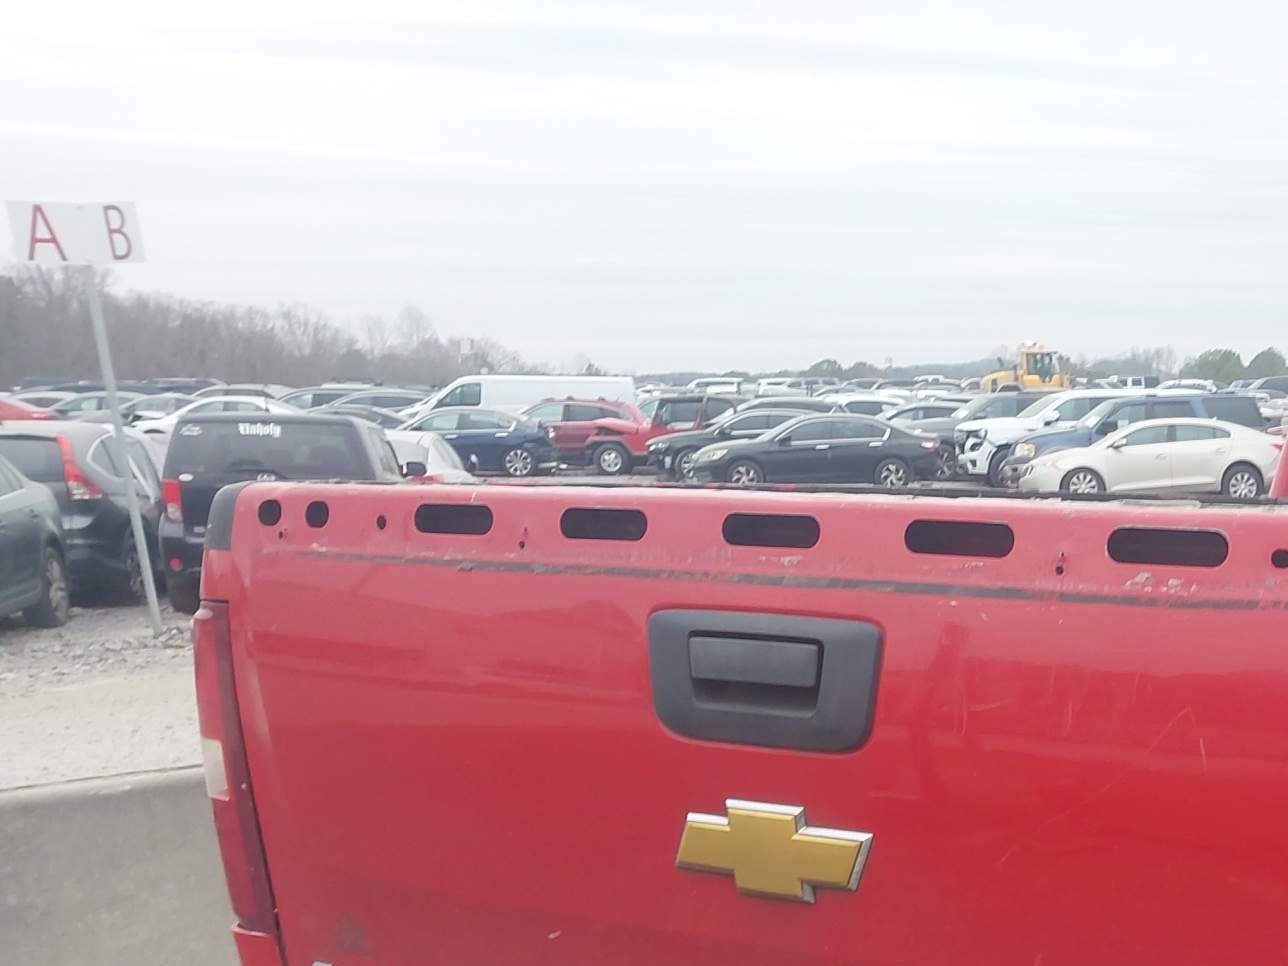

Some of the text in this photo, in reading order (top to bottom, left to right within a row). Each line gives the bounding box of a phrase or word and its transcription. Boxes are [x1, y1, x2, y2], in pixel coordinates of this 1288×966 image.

[28, 204, 132, 261] A B
[238, 422, 282, 438] Unholy
